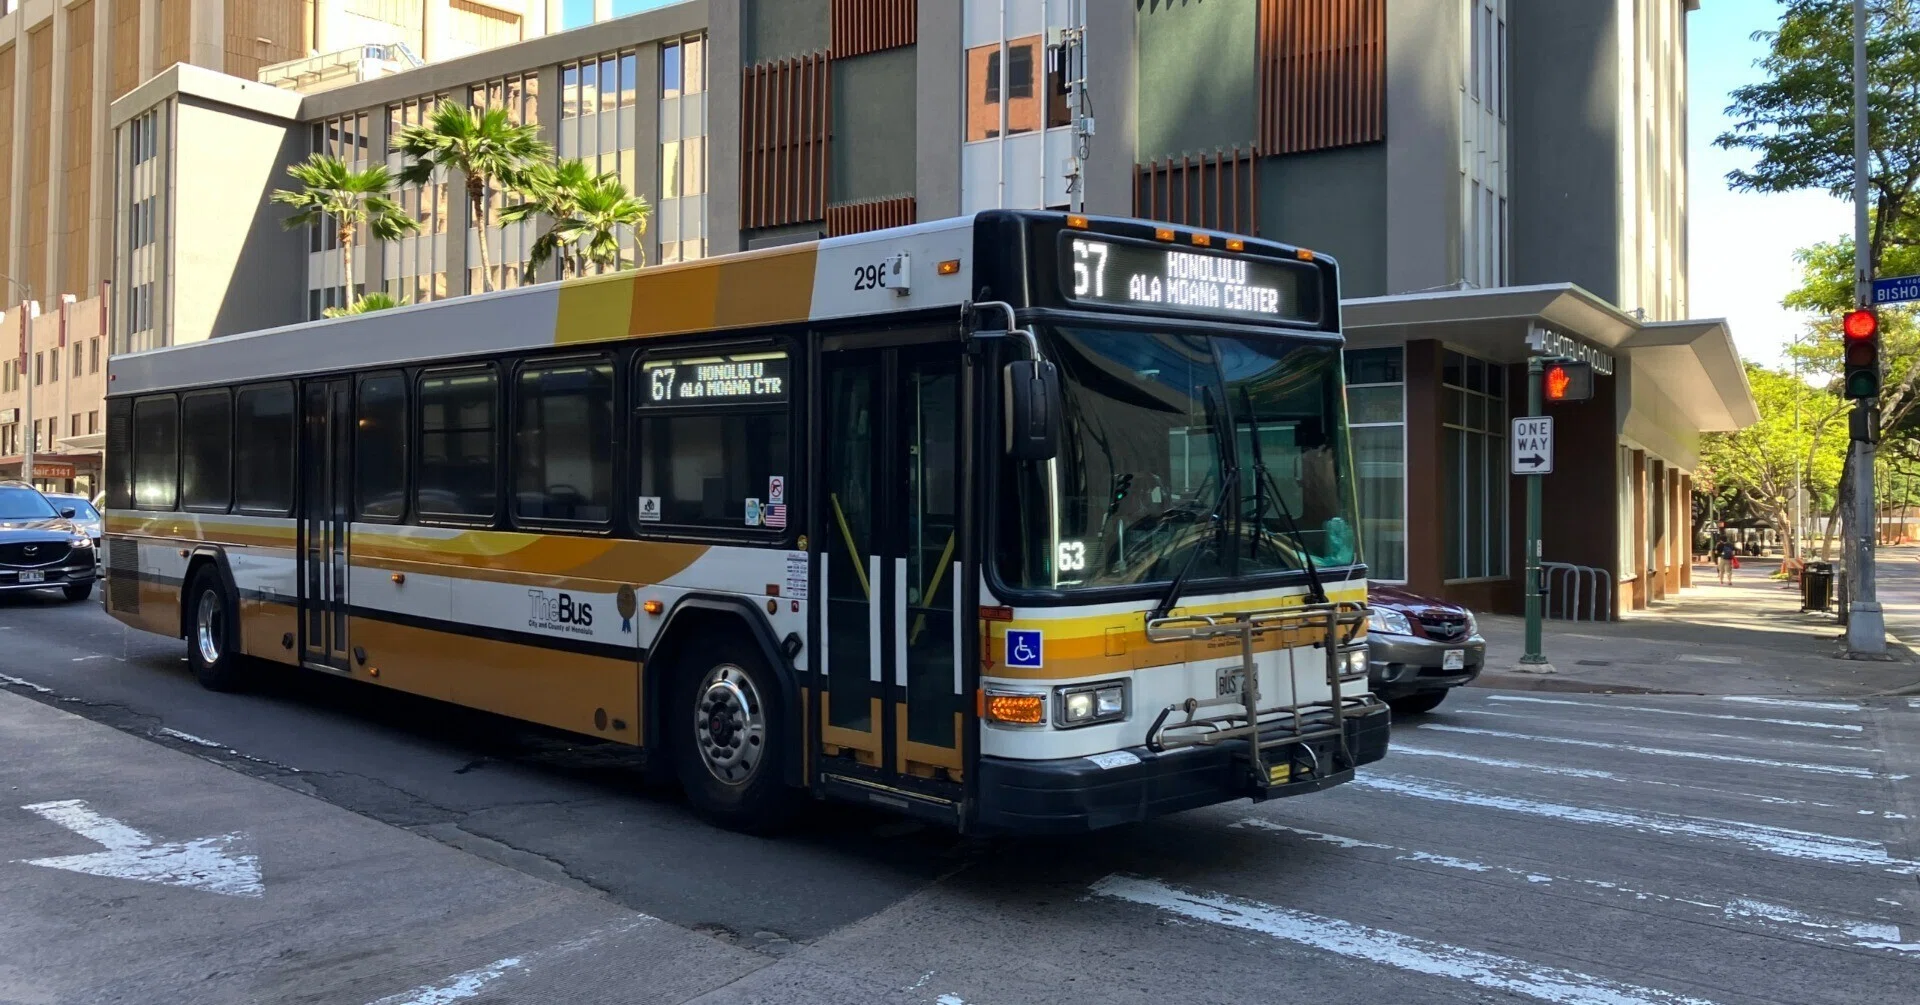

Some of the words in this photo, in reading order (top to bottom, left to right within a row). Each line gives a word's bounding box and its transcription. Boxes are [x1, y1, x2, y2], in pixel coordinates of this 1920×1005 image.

[1073, 239, 1107, 297] 67
[1167, 251, 1246, 284] HONOLULU
[1129, 274, 1162, 302] ALA
[1166, 278, 1220, 307] MOANA
[1224, 284, 1279, 313] CENTER
[1877, 285, 1919, 301] BISHO
[652, 368, 676, 400] 67
[697, 362, 763, 381] HONOLULU
[680, 382, 704, 397] ALA
[706, 380, 751, 396] MOANA
[754, 377, 782, 394] CTR
[1518, 422, 1548, 436] ONE
[1518, 438, 1548, 451] WAY
[1059, 541, 1085, 571] 63
[528, 589, 593, 627] TheBus
[1219, 675, 1236, 695] BUS
